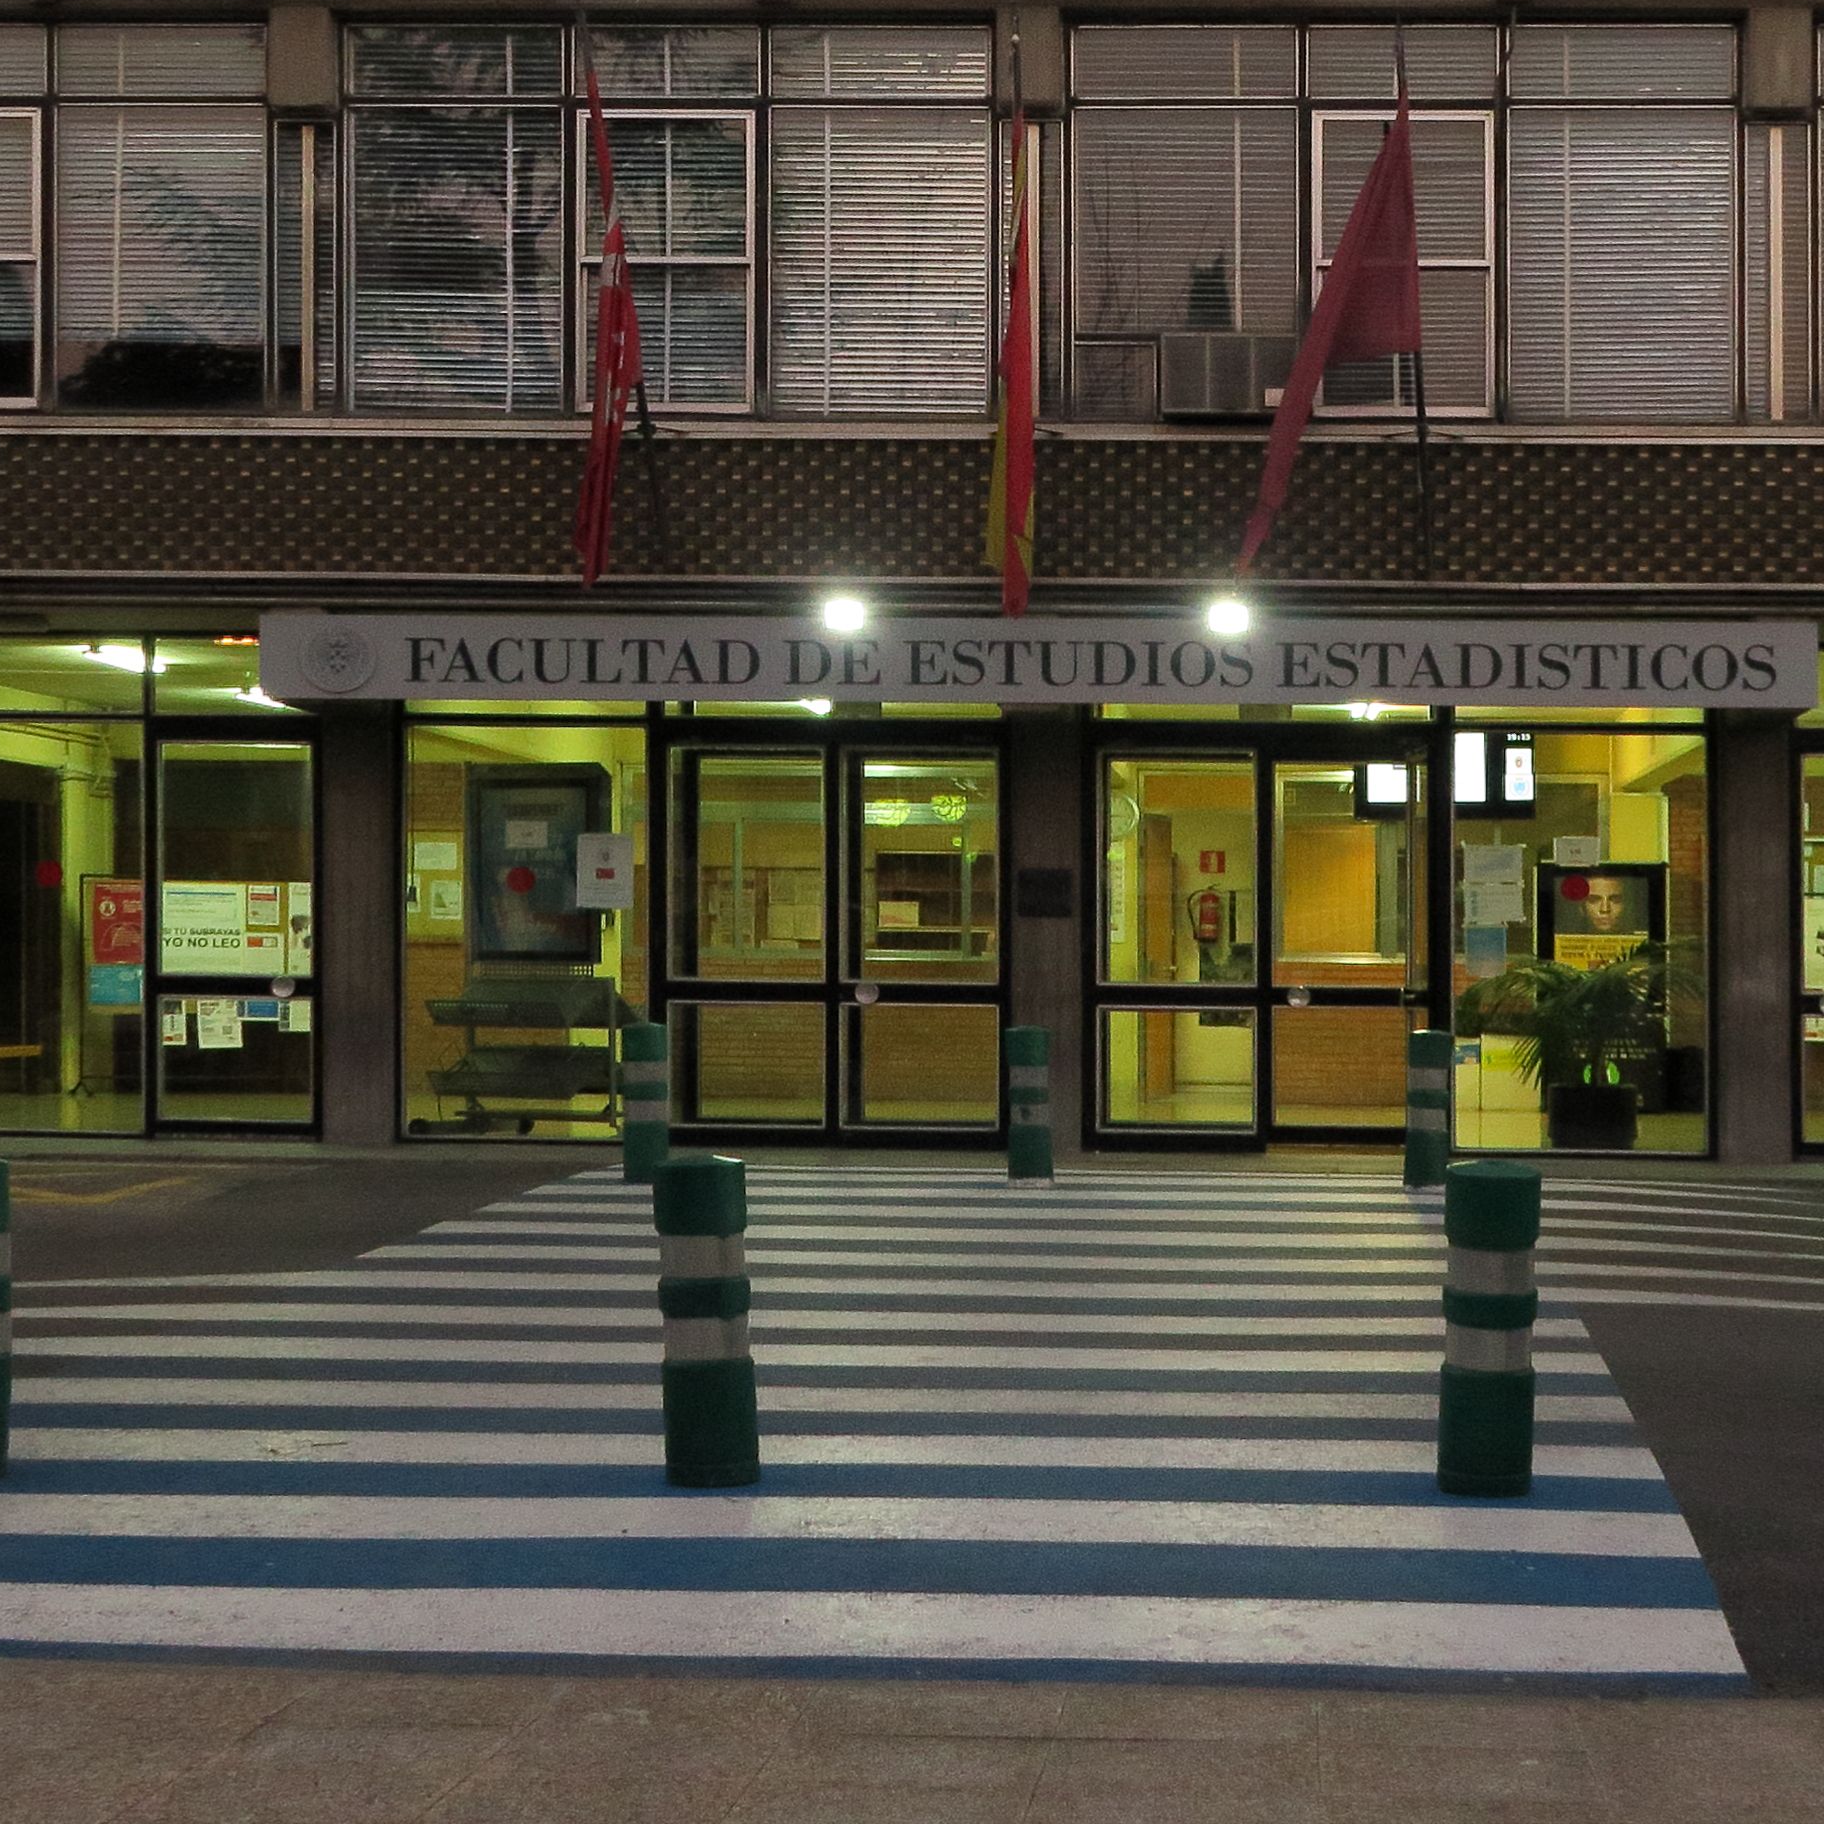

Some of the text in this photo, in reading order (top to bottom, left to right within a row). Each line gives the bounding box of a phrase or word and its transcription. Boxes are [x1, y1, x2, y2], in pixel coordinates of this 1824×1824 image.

[404, 636, 1778, 692] FACULTAD DE ESTUDIOS ESTADISTICOS
[190, 927, 241, 936] SUBRAYAS
[163, 937, 241, 949] YO NO LEO
